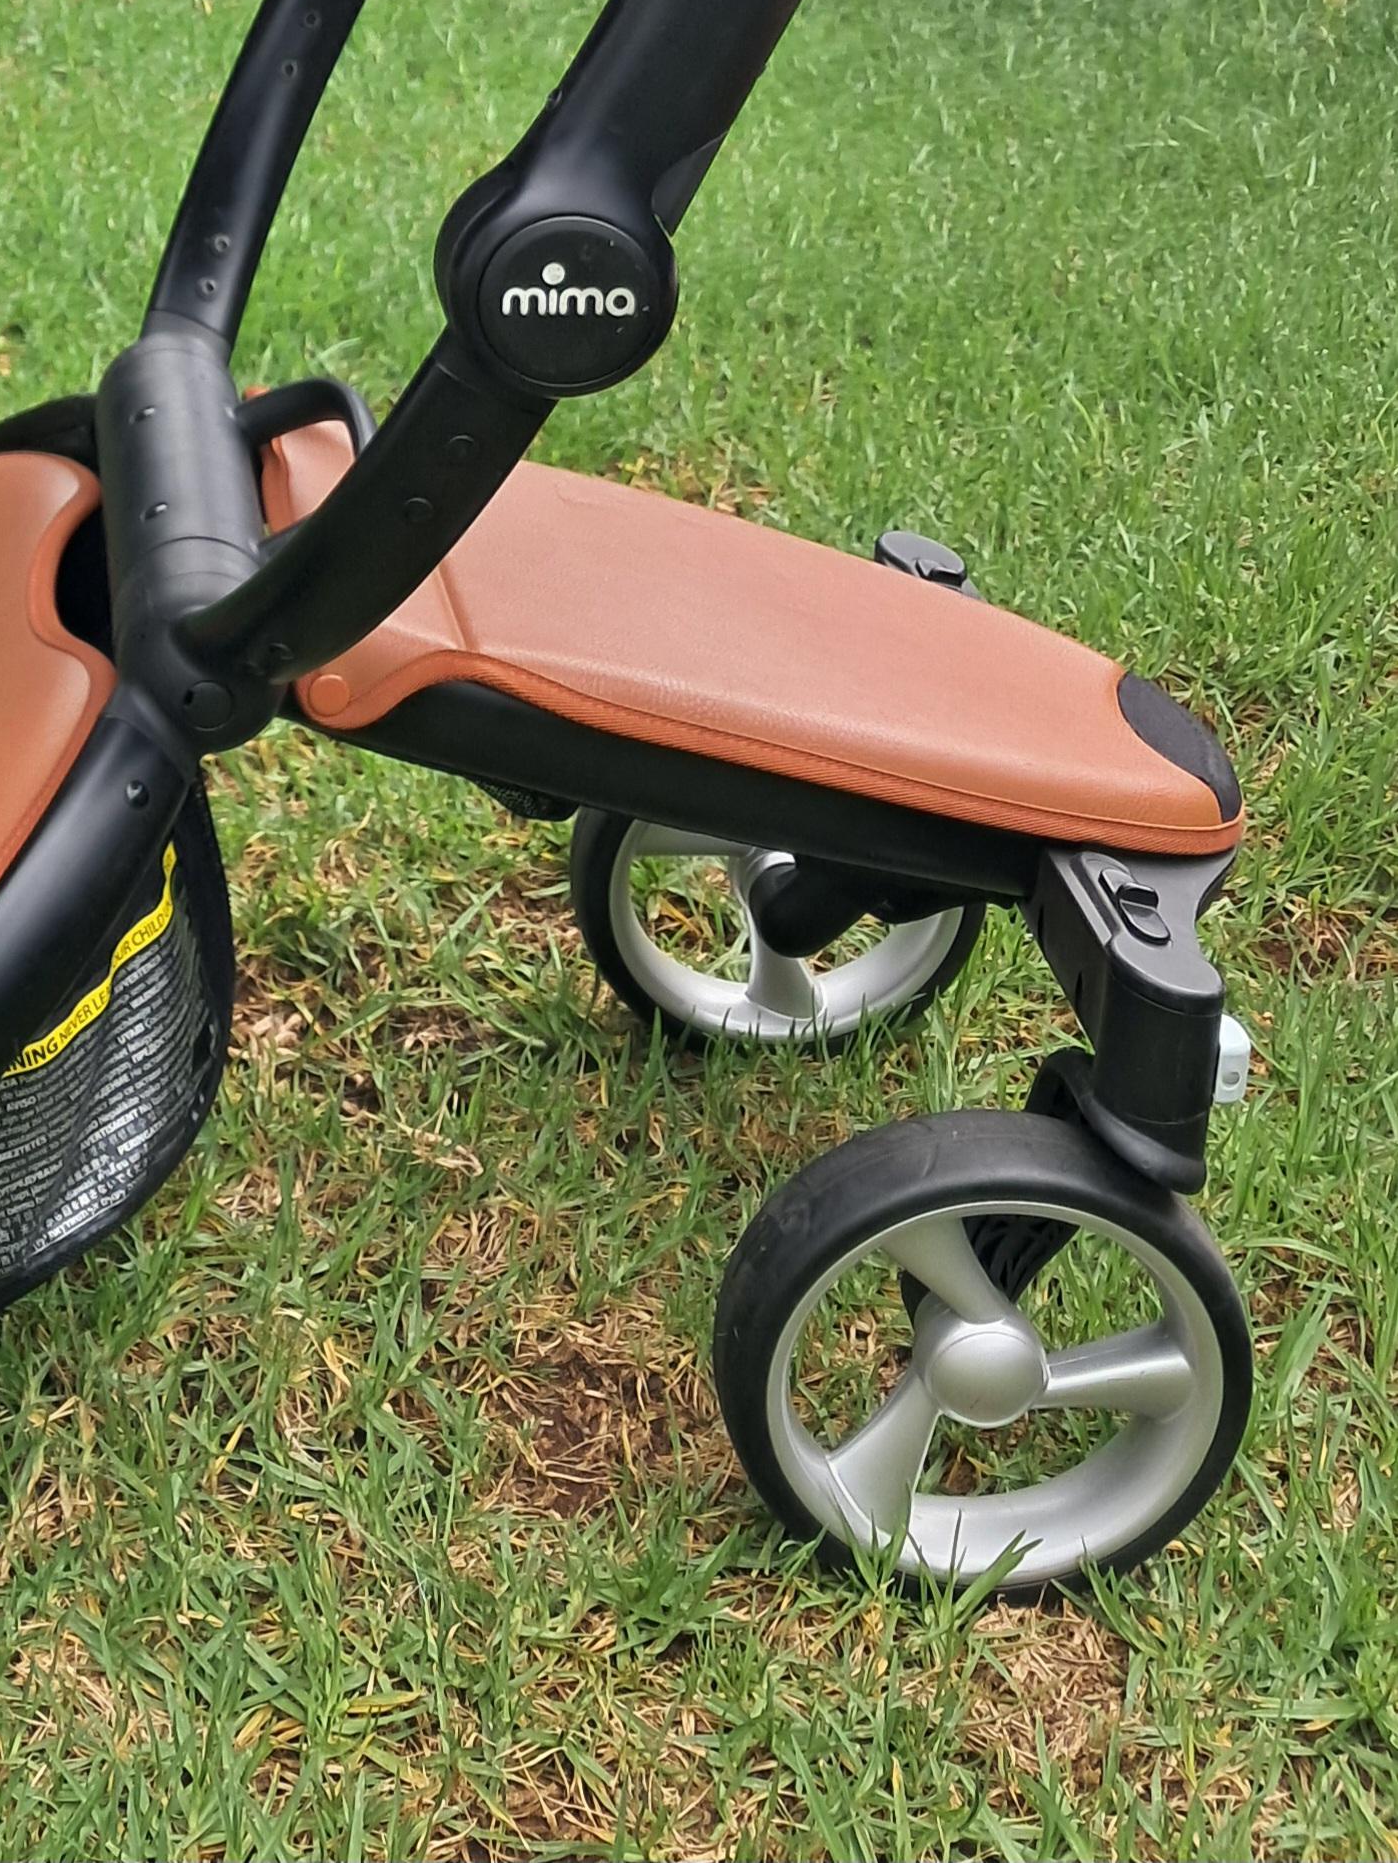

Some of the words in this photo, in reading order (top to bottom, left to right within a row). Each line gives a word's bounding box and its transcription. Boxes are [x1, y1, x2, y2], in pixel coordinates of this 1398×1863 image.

[502, 262, 636, 318] mima
[58, 1004, 93, 1044] NEVER
[131, 913, 165, 946] CHILD
